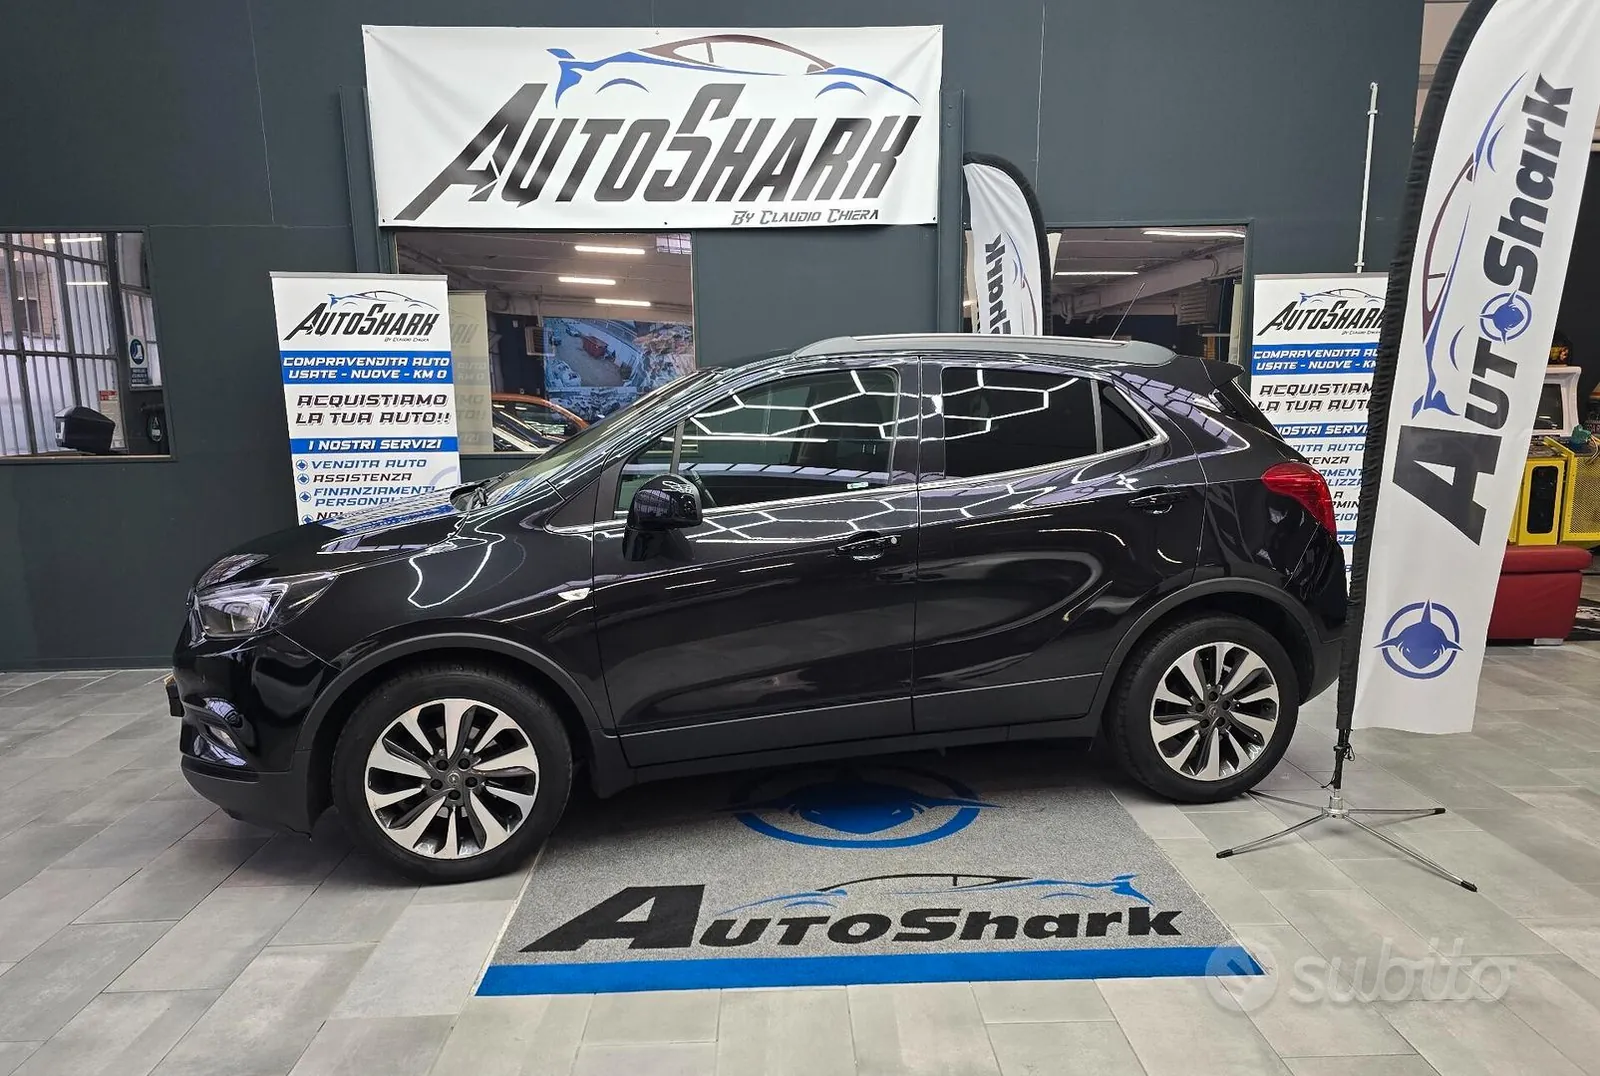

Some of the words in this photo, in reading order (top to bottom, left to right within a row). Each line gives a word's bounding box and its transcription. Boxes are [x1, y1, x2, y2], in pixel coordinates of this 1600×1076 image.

[1253, 349, 1361, 360] COMPRAVENDITA
[283, 357, 408, 367] COMPRAVENDITA
[412, 356, 450, 367] AUTO
[1256, 361, 1298, 371] USATE
[1308, 360, 1353, 370] NUOVE
[288, 369, 338, 379] USATE
[350, 369, 400, 379] NUOVE
[413, 369, 433, 379] KM
[1260, 383, 1373, 396] ACQUISTIAM
[296, 394, 448, 407] ACQUISTIAMO
[1286, 400, 1322, 411] TUA
[1327, 399, 1370, 410] AUT
[296, 412, 323, 424] LA
[330, 412, 373, 424] TUA
[379, 411, 450, 424] AUTO!!
[1324, 424, 1368, 434] SERVI
[308, 441, 314, 450] I
[318, 440, 376, 450] NOSTRI
[380, 439, 443, 449] SERVIZI
[311, 459, 380, 469] VENDITA
[385, 459, 427, 468] AUTO
[312, 473, 413, 483] ASSISTENZA
